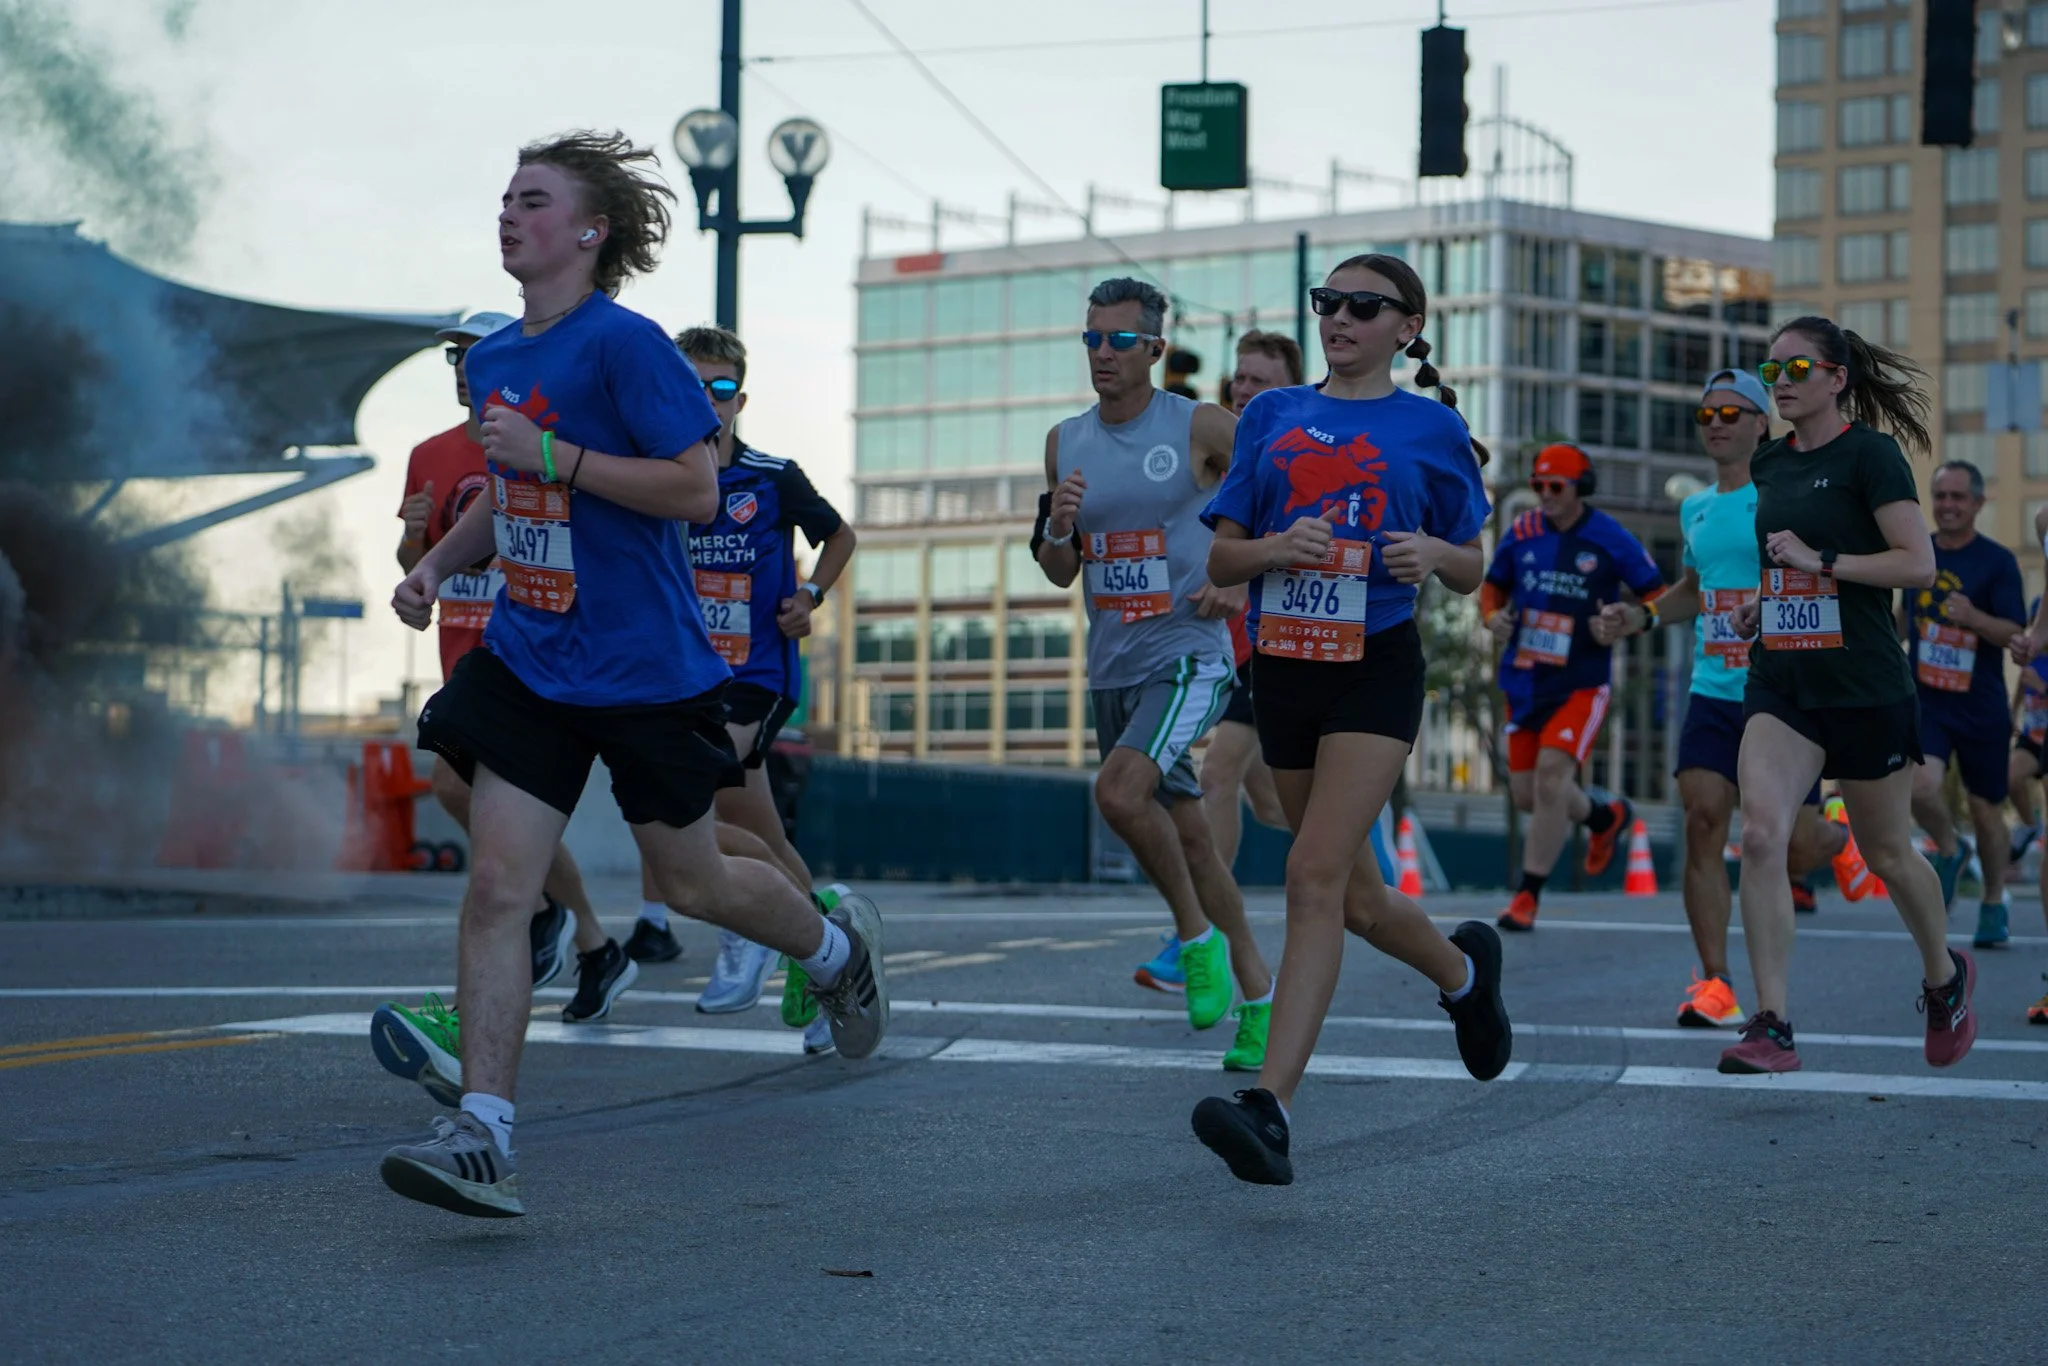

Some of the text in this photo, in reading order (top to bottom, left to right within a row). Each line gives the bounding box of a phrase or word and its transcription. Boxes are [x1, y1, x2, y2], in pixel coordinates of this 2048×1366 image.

[501, 386, 520, 404] 2023
[1307, 426, 1335, 444] 2023
[506, 523, 549, 563] 3497
[689, 533, 749, 550] MERCY
[691, 548, 756, 565] HEALTH
[452, 575, 490, 598] 4477
[1104, 564, 1149, 592] 4546
[1538, 570, 1586, 586] MERCY
[1282, 577, 1340, 615] 3496
[1538, 581, 1589, 599] HEALTH
[1777, 602, 1820, 630] 3360
[1278, 624, 1339, 639] MEDPACE
[1777, 638, 1823, 648] MEDPACE
